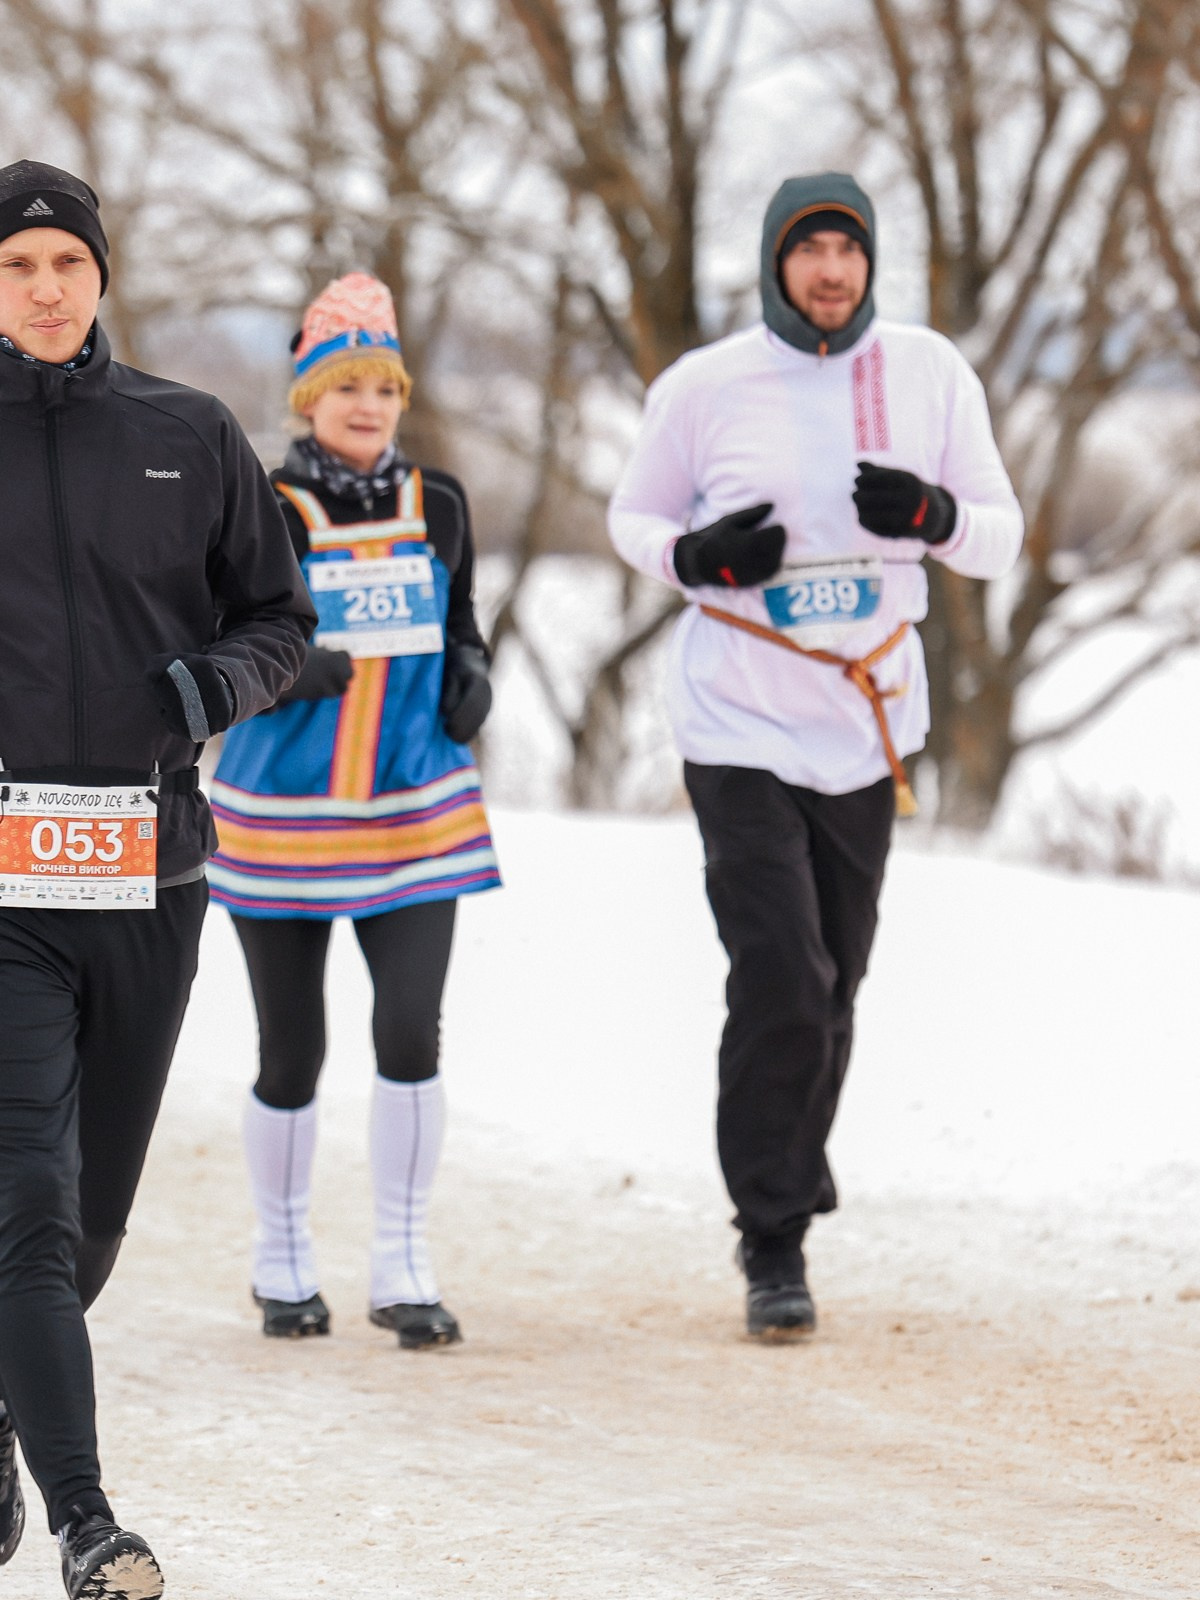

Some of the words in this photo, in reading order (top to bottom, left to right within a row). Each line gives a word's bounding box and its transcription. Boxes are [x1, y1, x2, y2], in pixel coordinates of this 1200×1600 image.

[145, 468, 181, 479] Reebok
[344, 585, 412, 623] 261
[787, 579, 859, 617] 289
[37, 791, 102, 807] NOVGOROD
[104, 795, 122, 808] ICE
[30, 819, 124, 862] 053
[30, 863, 76, 875] КОЧНЕВ
[79, 865, 122, 875] ВИКТОР
